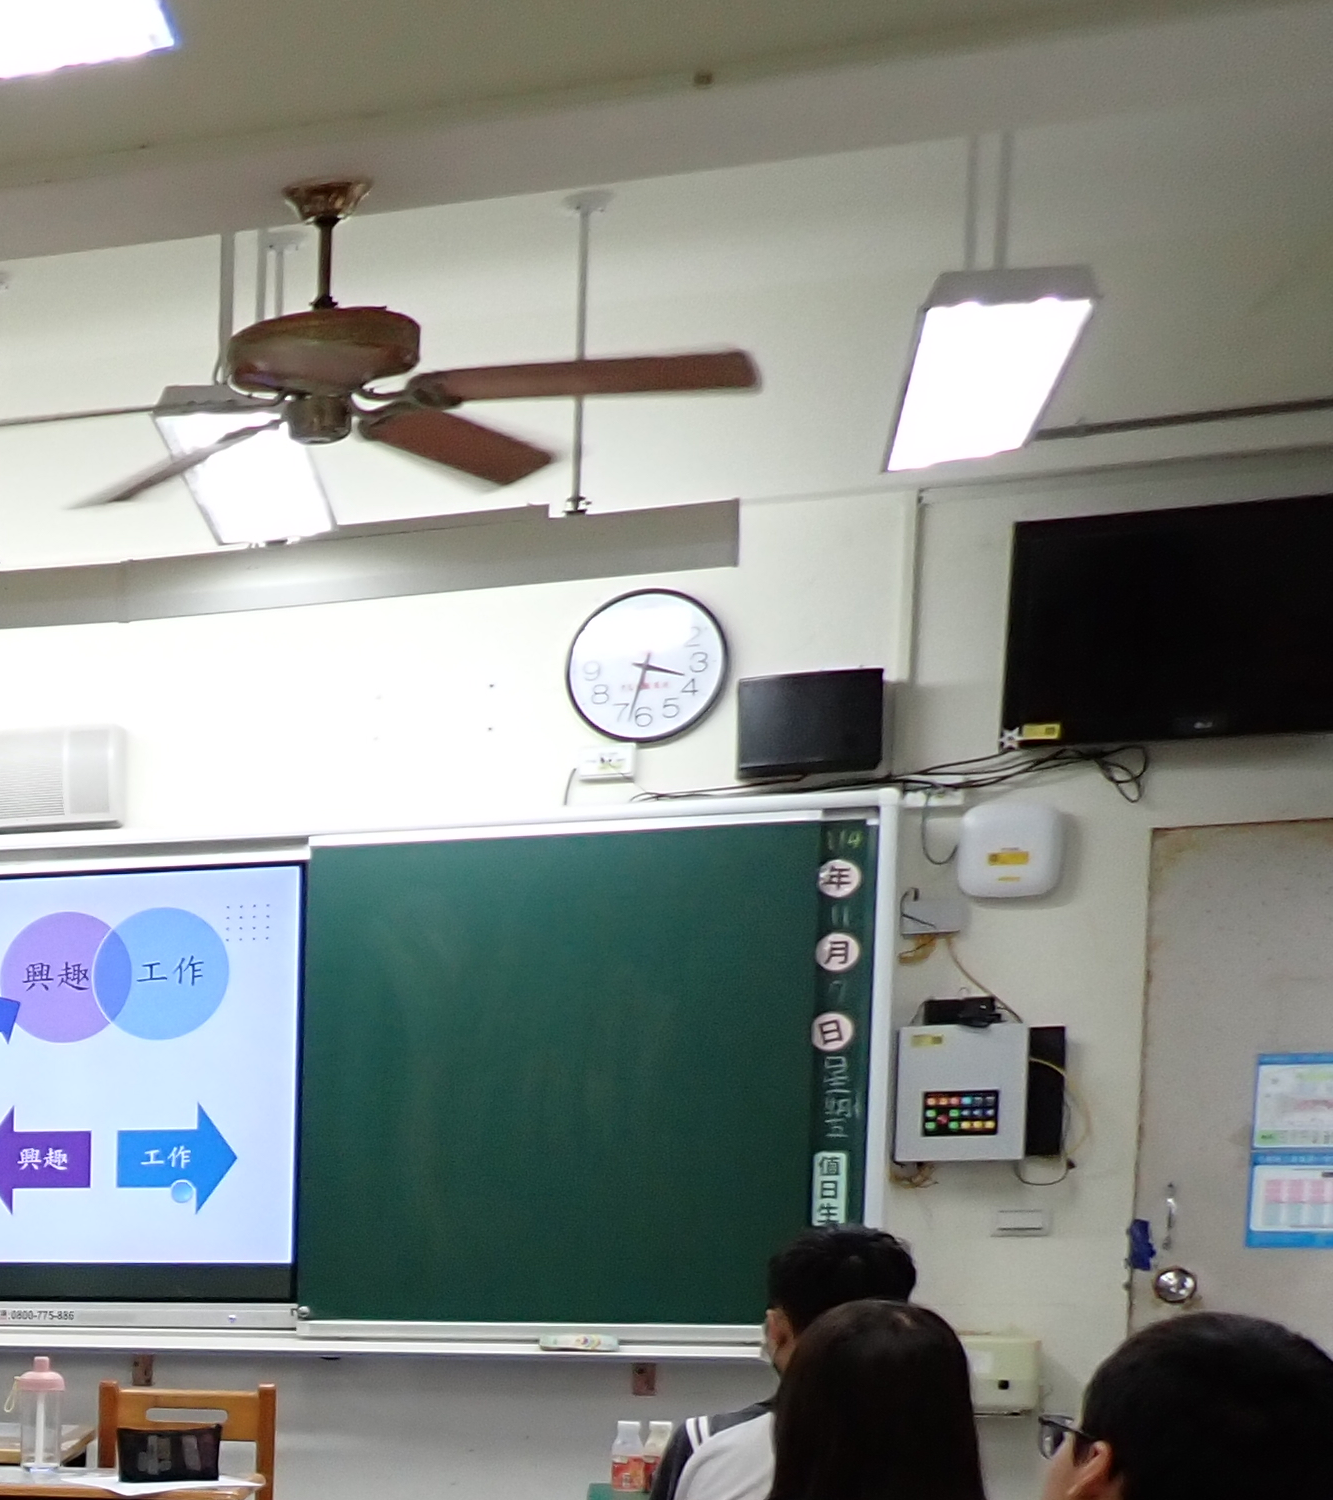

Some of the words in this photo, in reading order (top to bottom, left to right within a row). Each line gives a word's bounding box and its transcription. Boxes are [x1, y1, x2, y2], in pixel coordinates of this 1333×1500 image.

[689, 651, 709, 673] 3
[591, 683, 610, 705] 8
[680, 677, 699, 697] 4
[613, 702, 630, 723] 7
[634, 706, 653, 728] 6
[662, 697, 680, 719] 5
[821, 866, 852, 890] 年
[824, 940, 850, 966] 月
[22, 961, 90, 992] 興趣
[136, 955, 204, 986] 工作
[818, 1018, 844, 1046] 日
[17, 1147, 68, 1171] 興趣
[140, 1145, 191, 1169] 工作
[816, 1156, 842, 1224] 值日生
